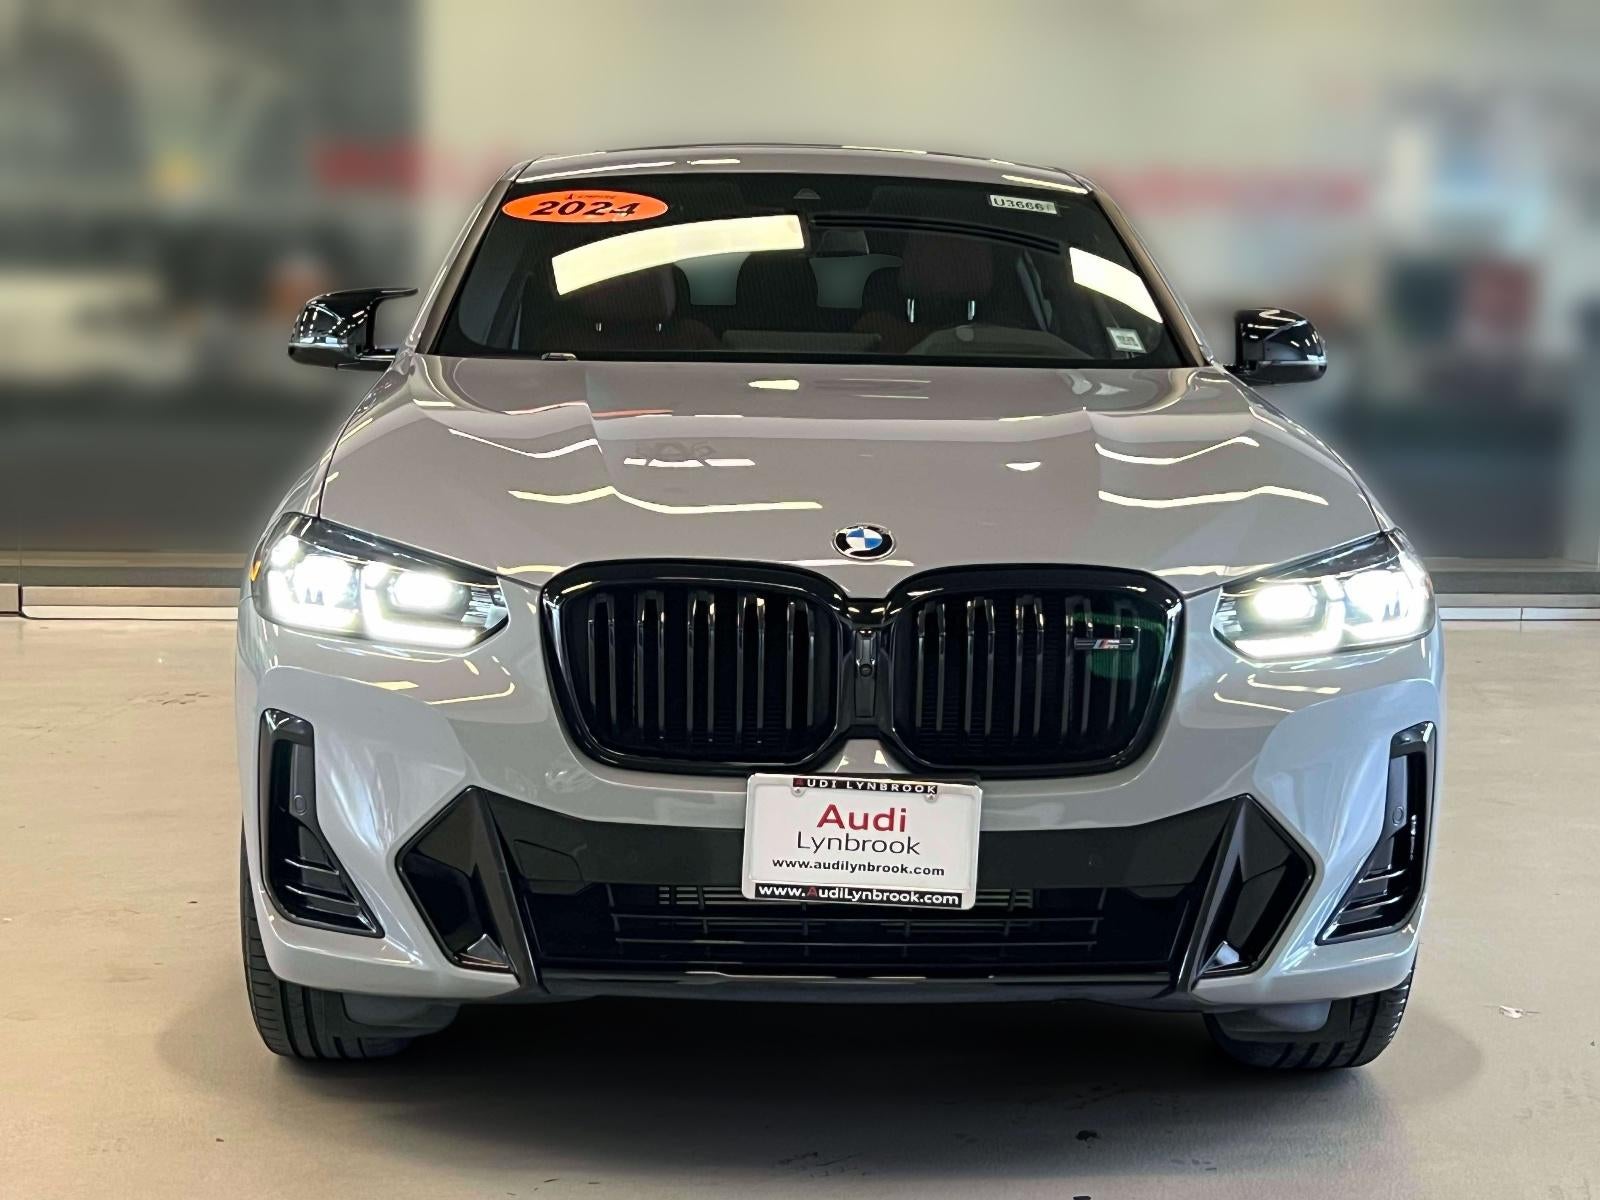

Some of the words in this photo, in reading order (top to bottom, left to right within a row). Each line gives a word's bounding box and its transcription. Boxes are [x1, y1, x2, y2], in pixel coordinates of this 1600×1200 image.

[529, 200, 640, 216] 2024
[794, 778, 837, 788] AUDI
[846, 781, 936, 794] LYNBROOK
[816, 803, 906, 832] Audi
[797, 831, 921, 855] Lynbrook
[772, 858, 945, 876] www.audilynbrook.com
[758, 885, 959, 905] www.AudiLynbrook.com
